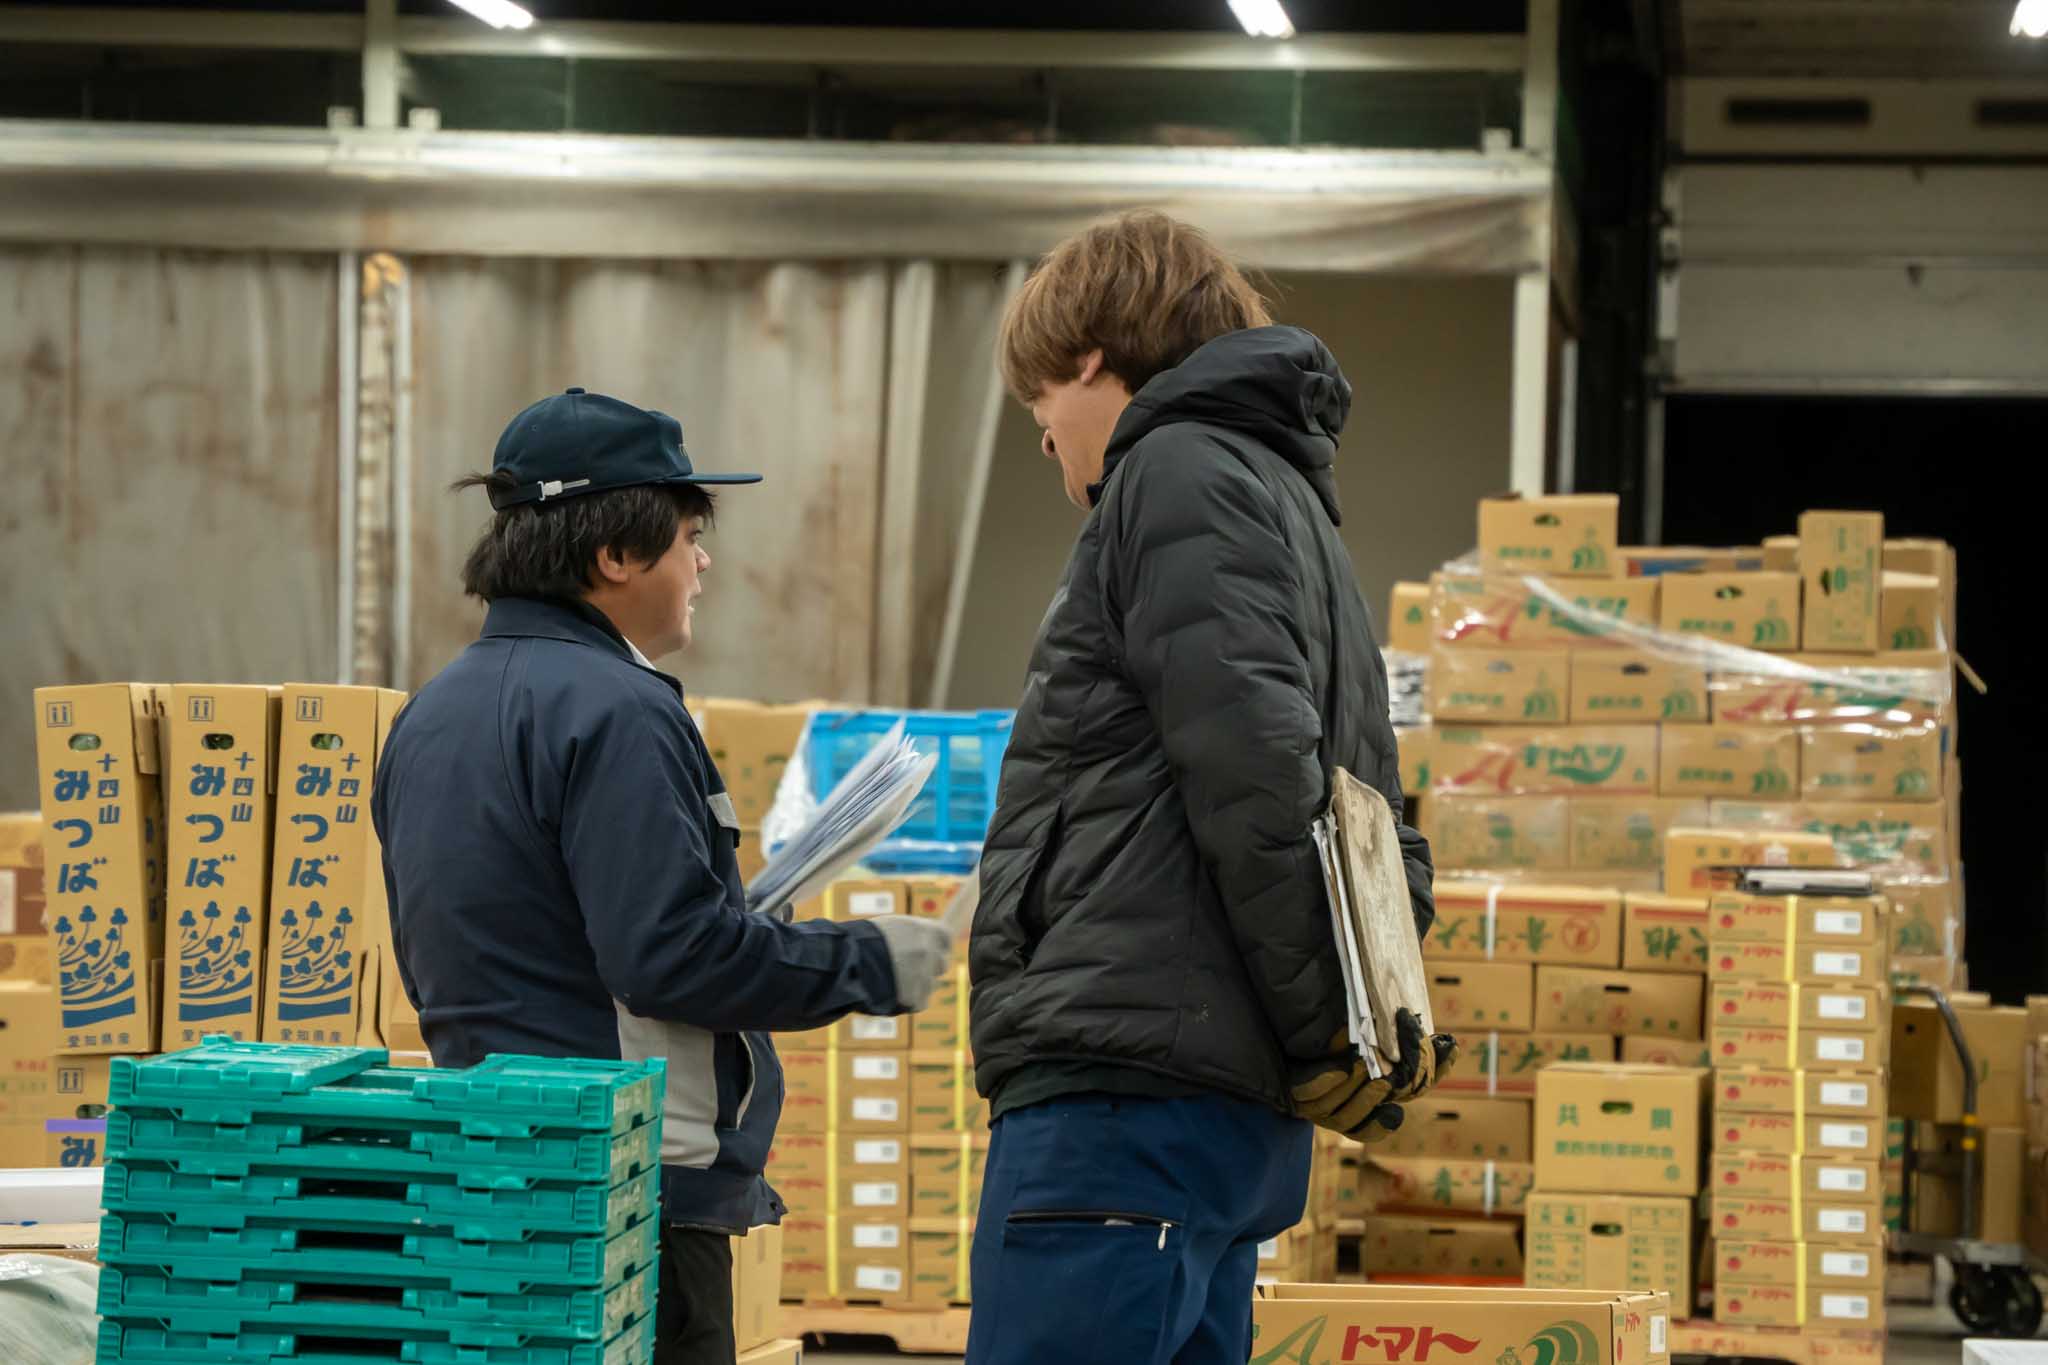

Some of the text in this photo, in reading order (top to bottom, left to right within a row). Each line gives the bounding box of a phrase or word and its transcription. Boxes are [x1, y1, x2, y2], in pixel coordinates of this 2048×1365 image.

[96, 752, 121, 825] 十四山
[231, 751, 256, 822] 十四山
[336, 752, 361, 823] 十四山
[53, 769, 107, 893] みつば
[185, 763, 237, 888] みつば
[288, 763, 339, 888] みつば
[182, 1029, 243, 1042] 愛産
[279, 1028, 342, 1042] 愛知県産
[1339, 1325, 1482, 1362] トマト
